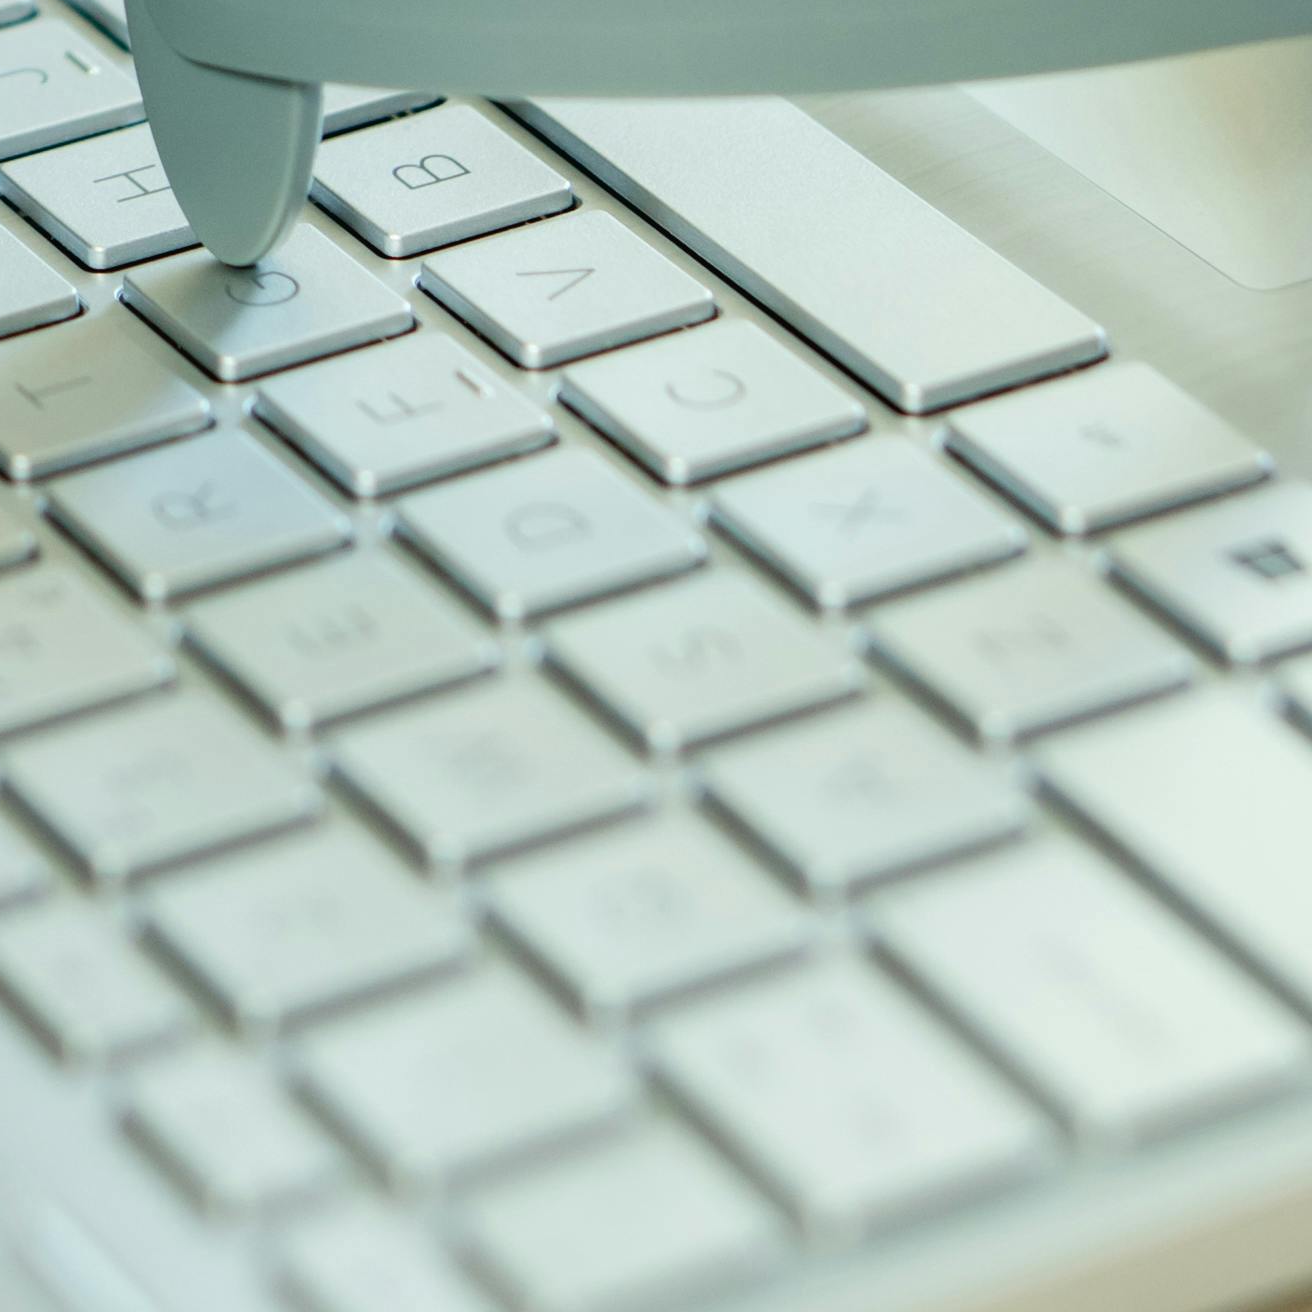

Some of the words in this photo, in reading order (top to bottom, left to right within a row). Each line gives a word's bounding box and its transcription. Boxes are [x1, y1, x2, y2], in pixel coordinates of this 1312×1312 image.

[91, 163, 172, 204] H
[390, 152, 472, 191] B
[224, 270, 302, 307] G
[514, 266, 598, 303] V
[13, 374, 95, 412] T
[353, 388, 447, 427] F
[662, 367, 749, 413] C
[149, 479, 242, 532] R
